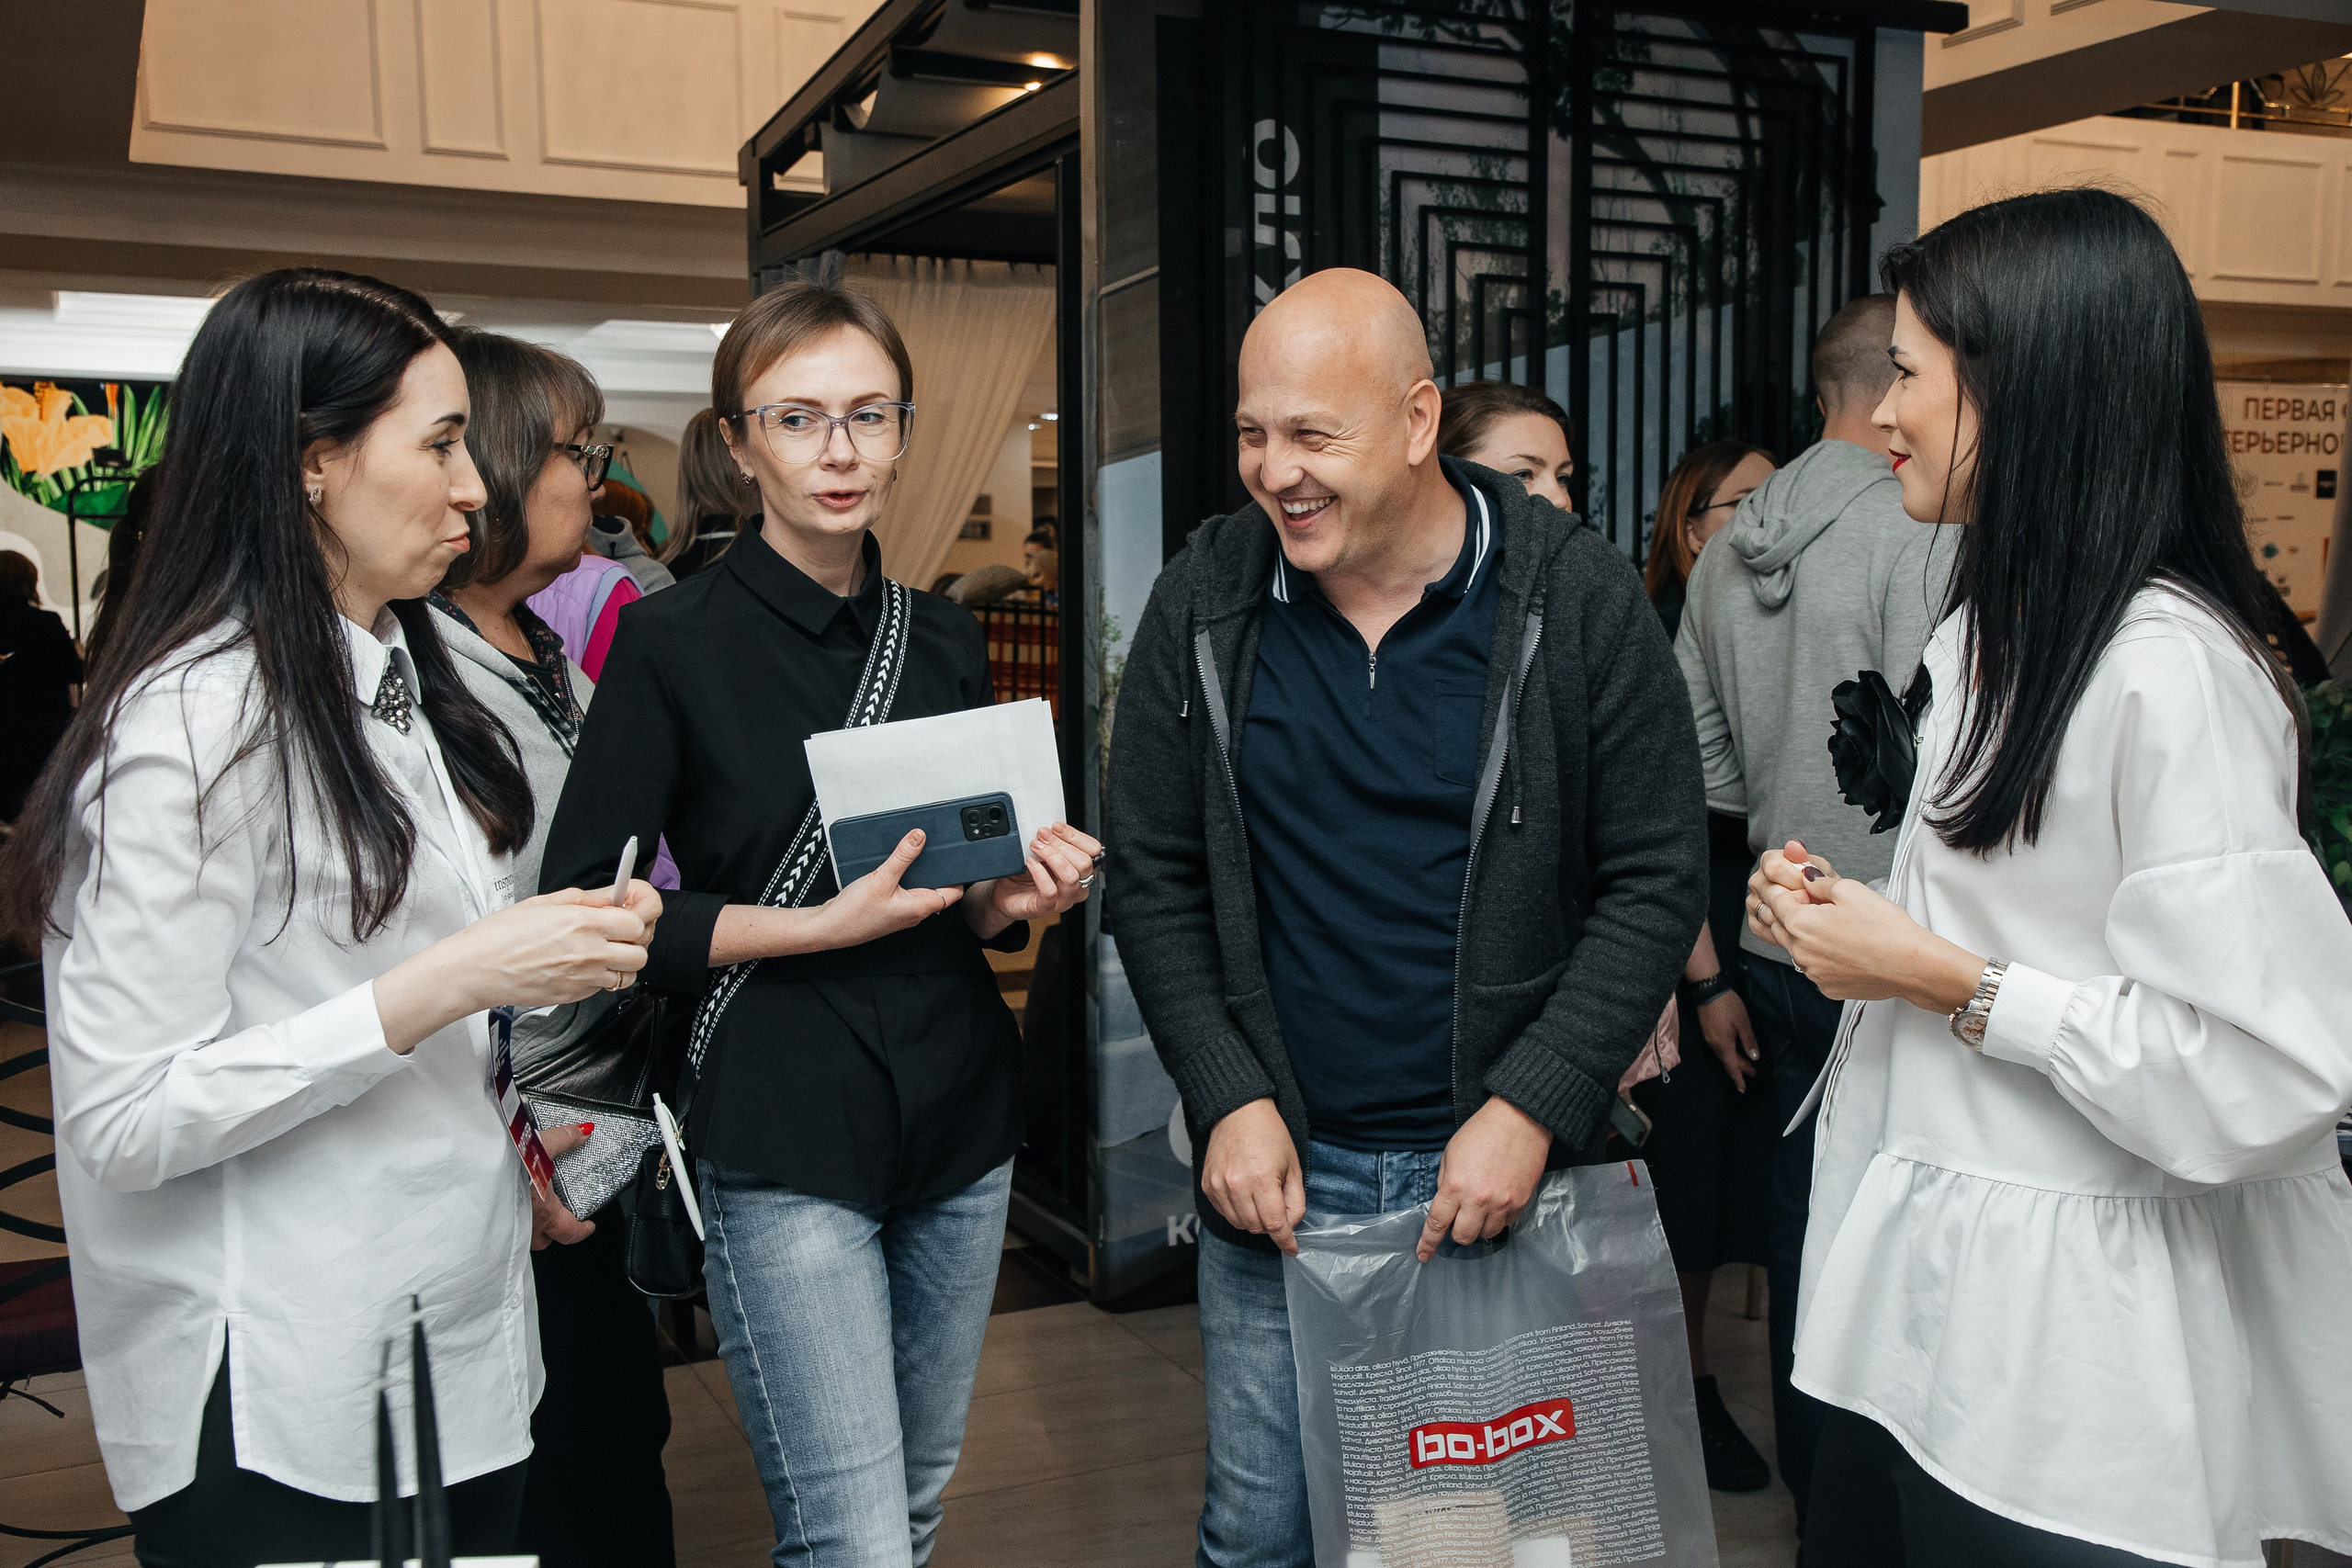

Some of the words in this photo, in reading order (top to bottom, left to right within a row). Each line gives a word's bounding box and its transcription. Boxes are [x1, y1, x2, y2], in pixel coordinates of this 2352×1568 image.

[2245, 398, 2335, 422] ПЕРВАЯ
[2224, 430, 2345, 456] ЕРЬЕРНО
[1385, 1441, 1408, 1451] Tradem
[1416, 1409, 1567, 1463] bo-box
